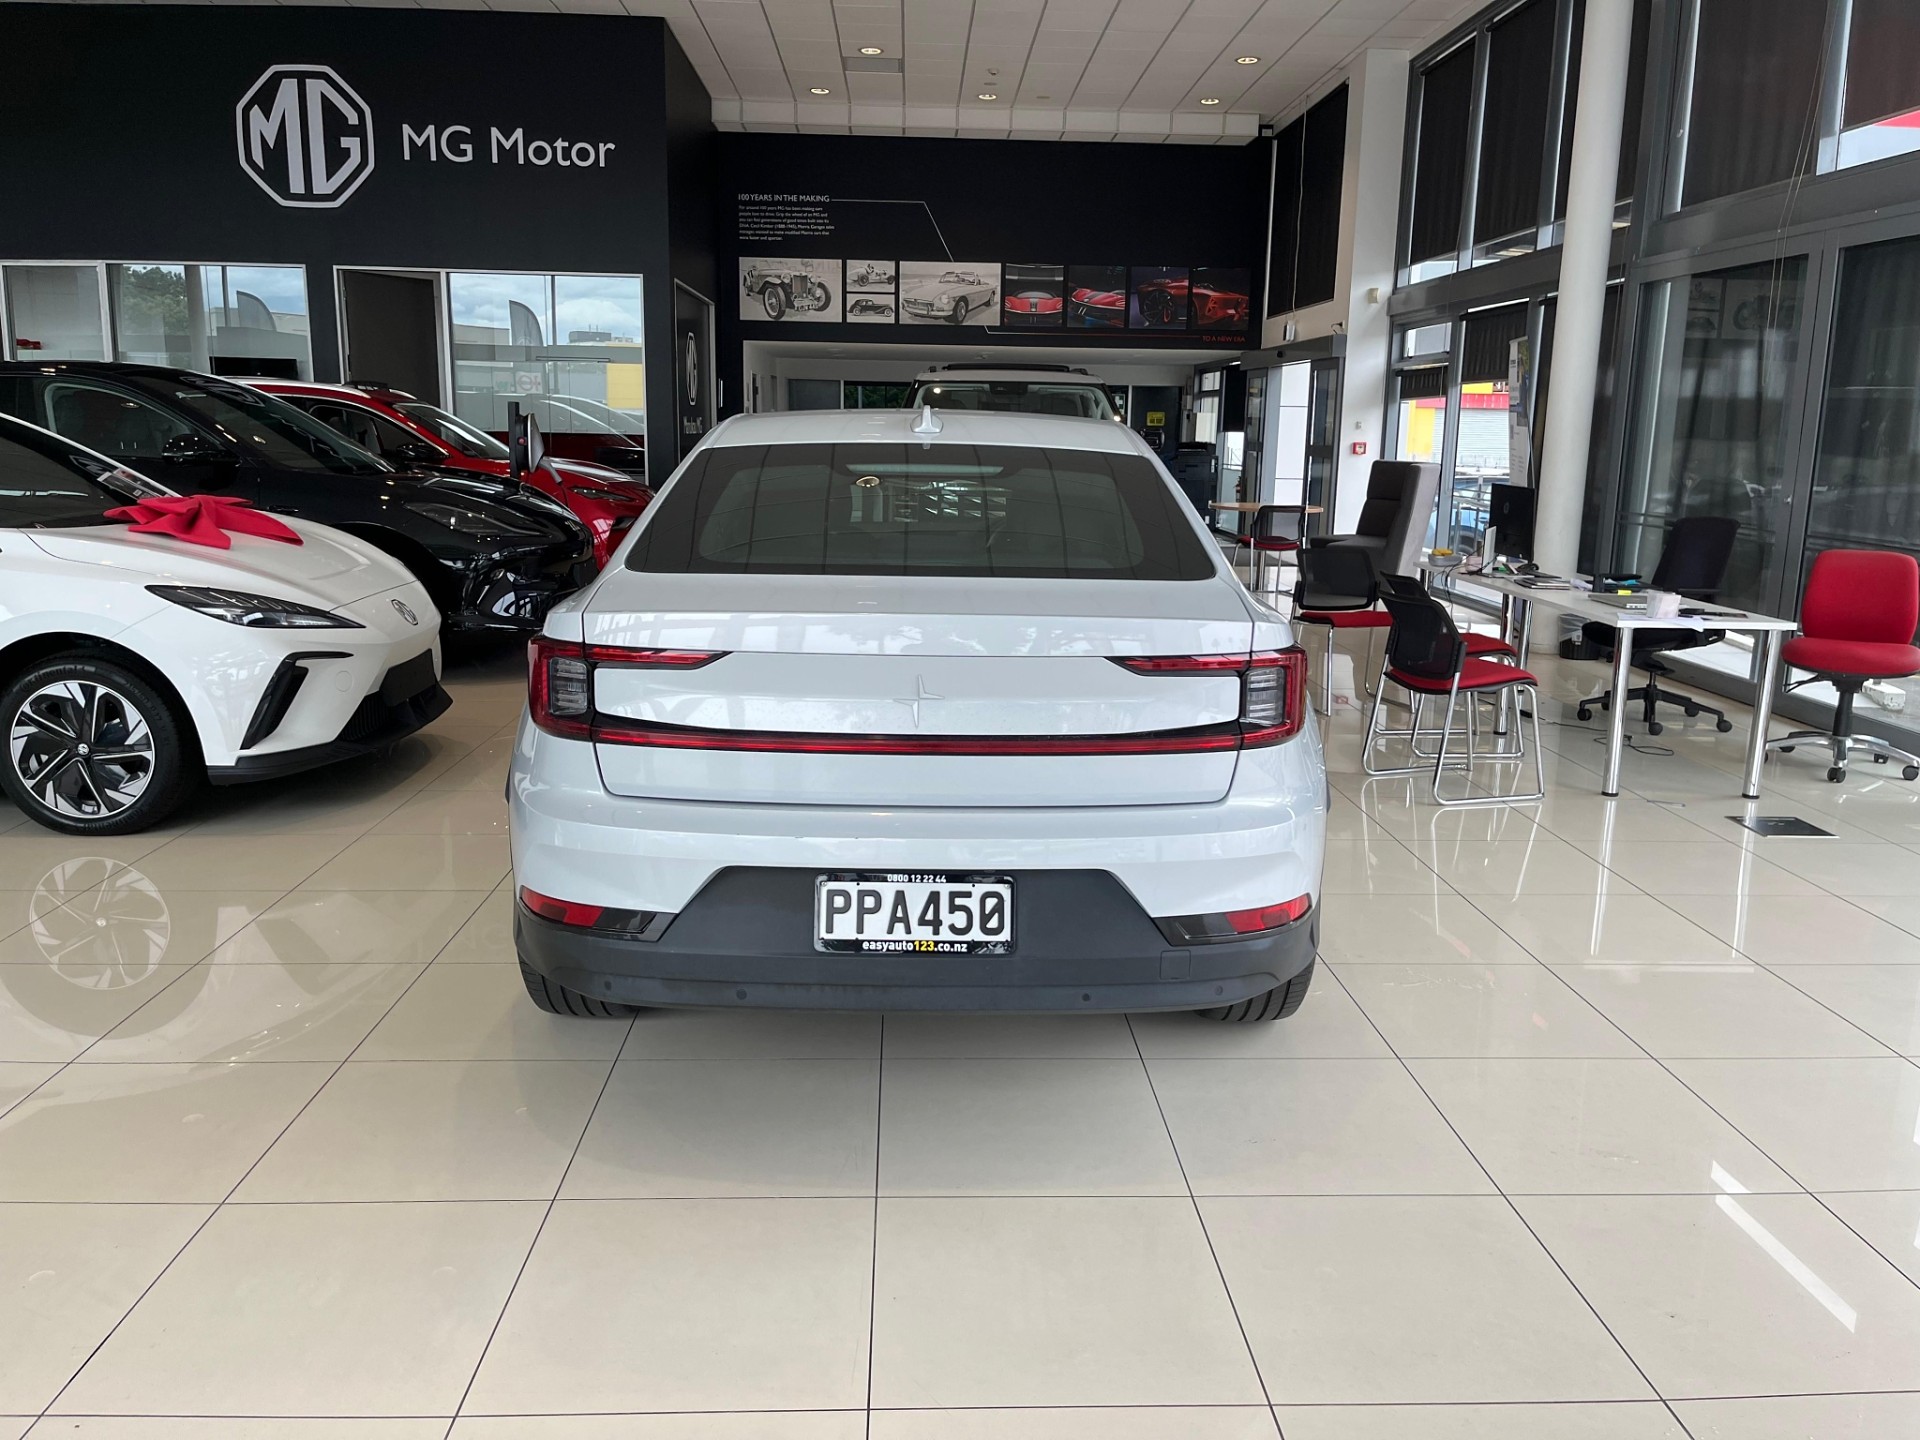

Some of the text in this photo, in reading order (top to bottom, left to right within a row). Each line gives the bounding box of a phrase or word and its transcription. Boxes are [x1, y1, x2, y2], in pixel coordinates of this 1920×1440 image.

[246, 75, 366, 198] MG
[402, 122, 616, 168] MG Motor
[738, 193, 830, 203] 100 YEARS IN THE MAKING
[1217, 335, 1233, 343] NEW
[1233, 335, 1246, 343] ERA
[887, 874, 947, 883] 0800 12 22 44
[825, 889, 1005, 936] PPA450
[862, 940, 968, 953] easyauto123.co.nz
